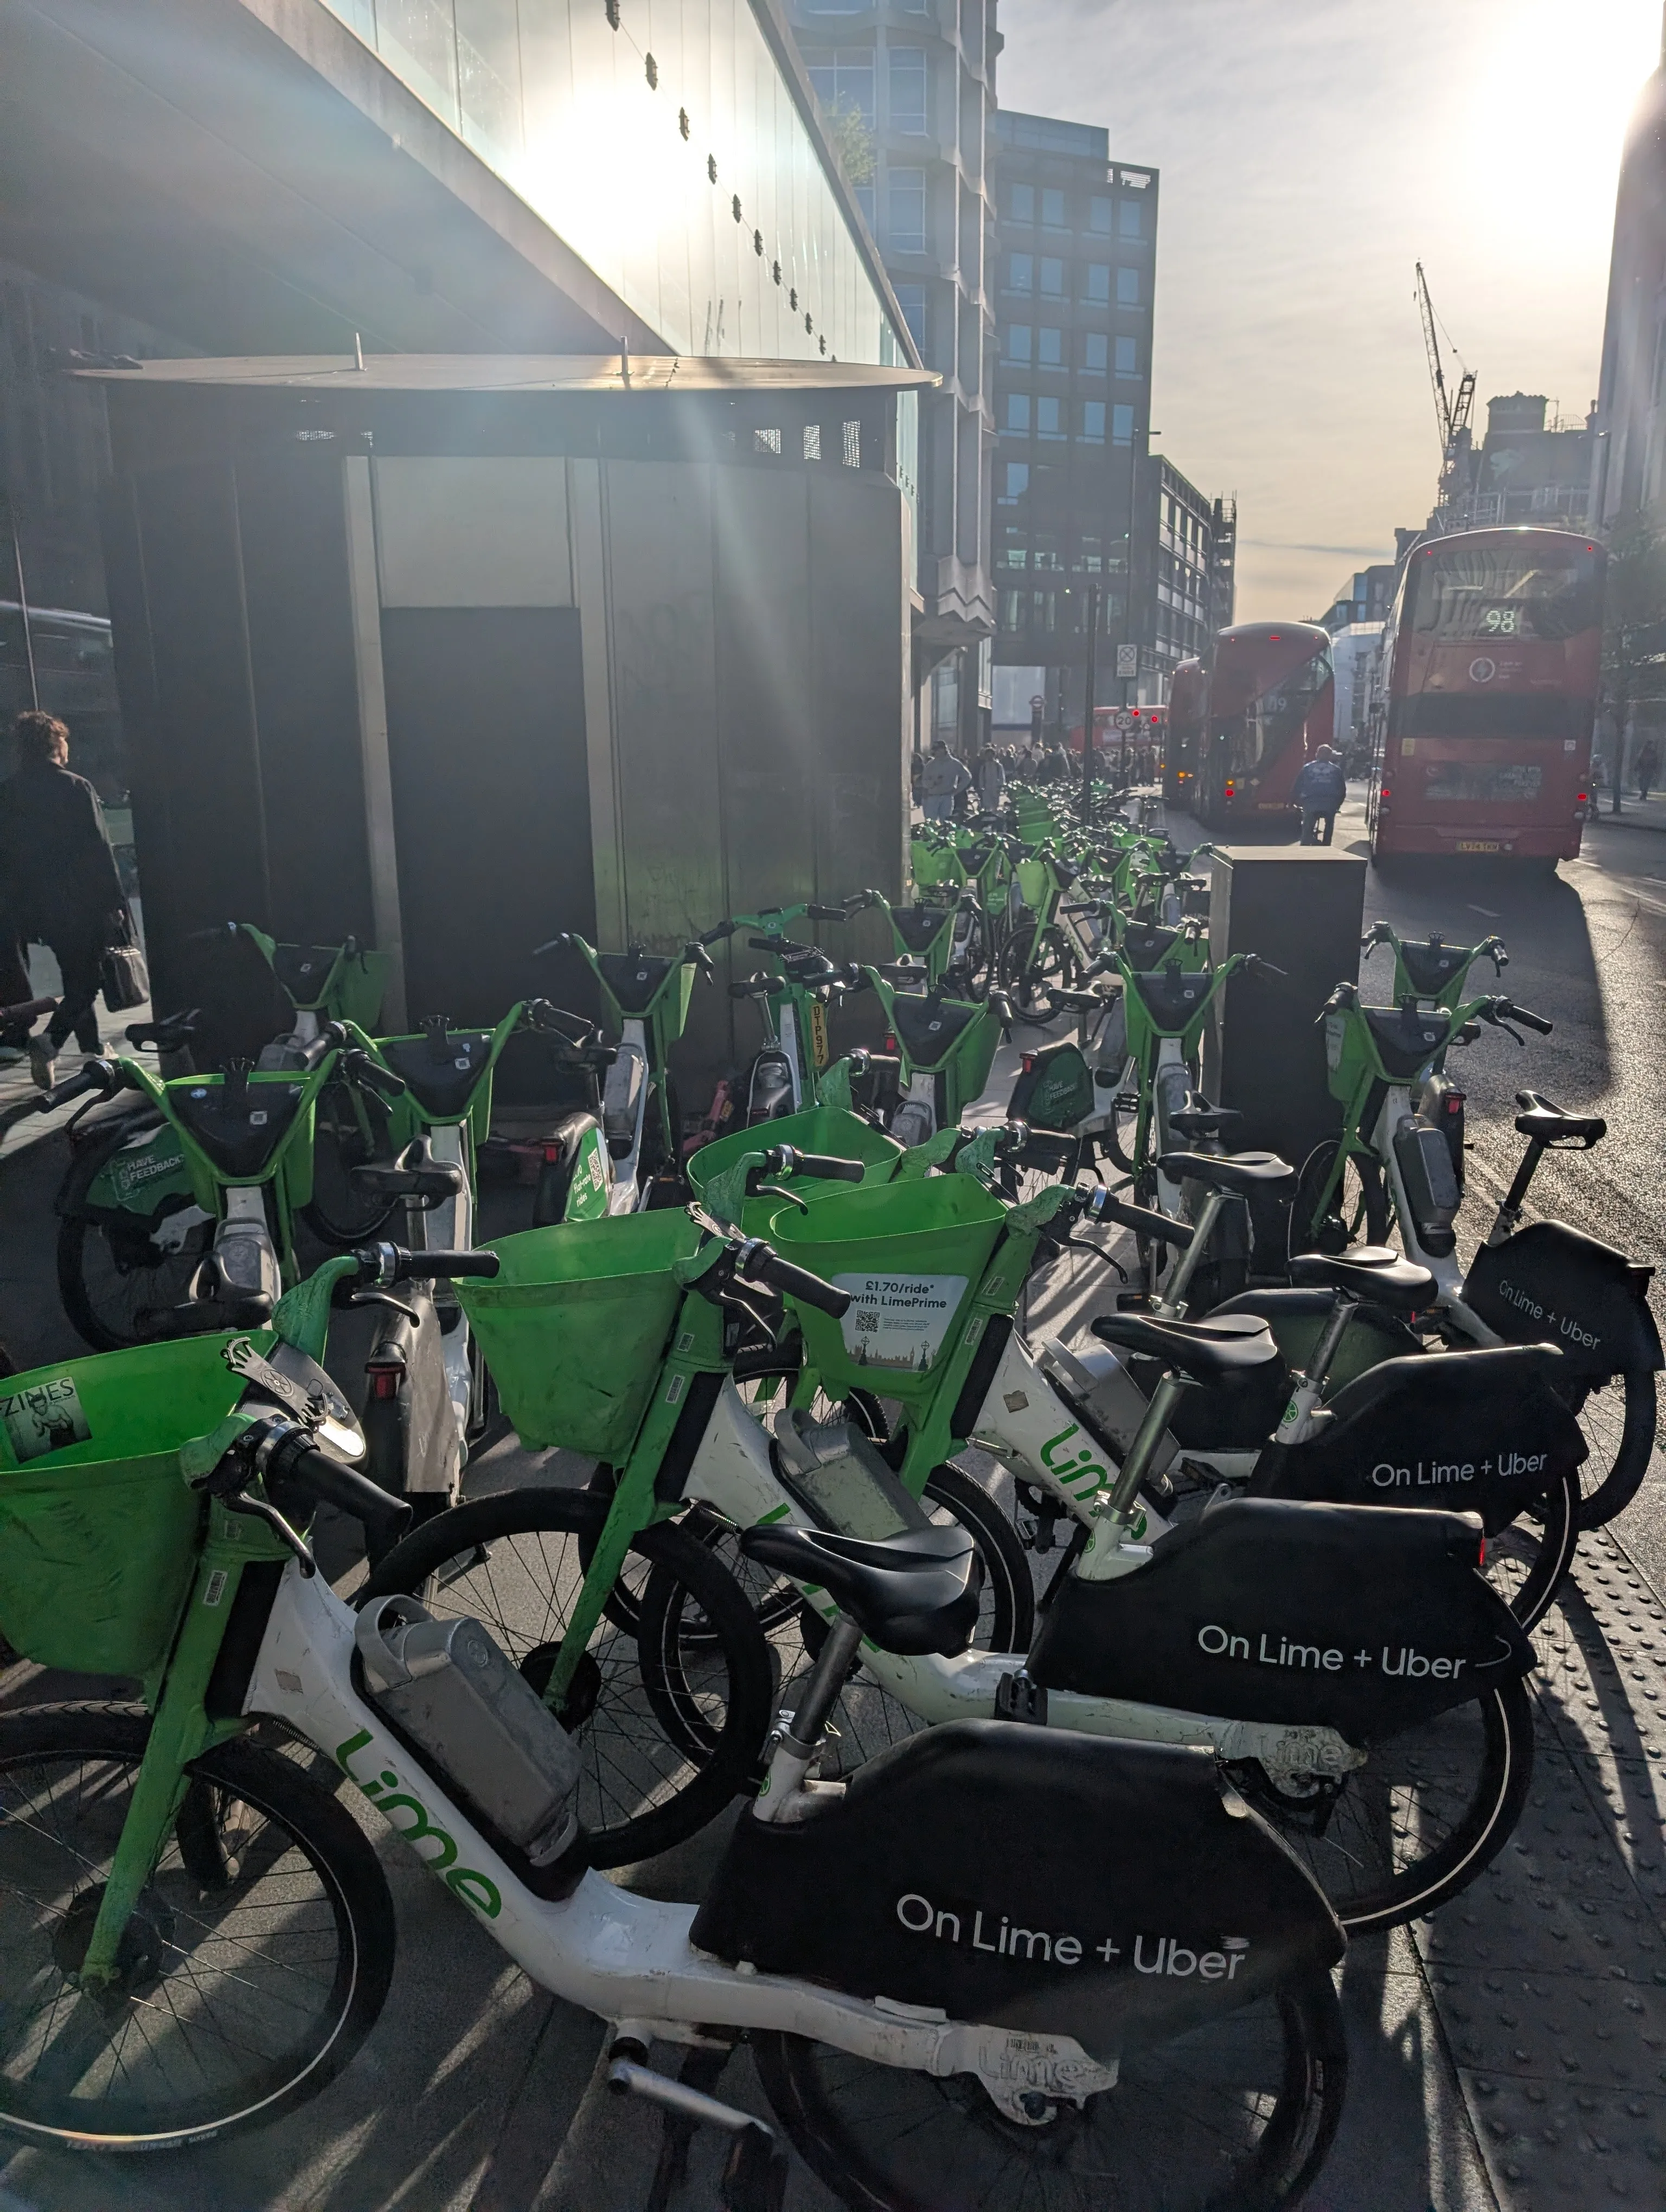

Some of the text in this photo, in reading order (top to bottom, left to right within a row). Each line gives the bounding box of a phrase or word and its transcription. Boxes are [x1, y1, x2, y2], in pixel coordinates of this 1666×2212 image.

[1486, 610, 1514, 633] 98
[1117, 716, 1131, 725] 20
[126, 1154, 156, 1172] HAVE
[576, 1192, 588, 1207] rides
[850, 1294, 947, 1308] with LimePrime
[1500, 1280, 1513, 1301] On
[1513, 1290, 1543, 1319] Lime
[1560, 1316, 1601, 1350] Uber
[1372, 1463, 1410, 1486] On
[1418, 1461, 1475, 1485] Lime
[1498, 1452, 1548, 1476] Uber
[1198, 1625, 1249, 1659] On
[1259, 1634, 1344, 1670] Lime
[1381, 1647, 1466, 1679] Uber
[336, 1728, 502, 1920] Lime
[896, 1893, 960, 1942] On
[972, 1911, 1082, 1965] Lime
[1133, 1935, 1246, 1979] Uber
